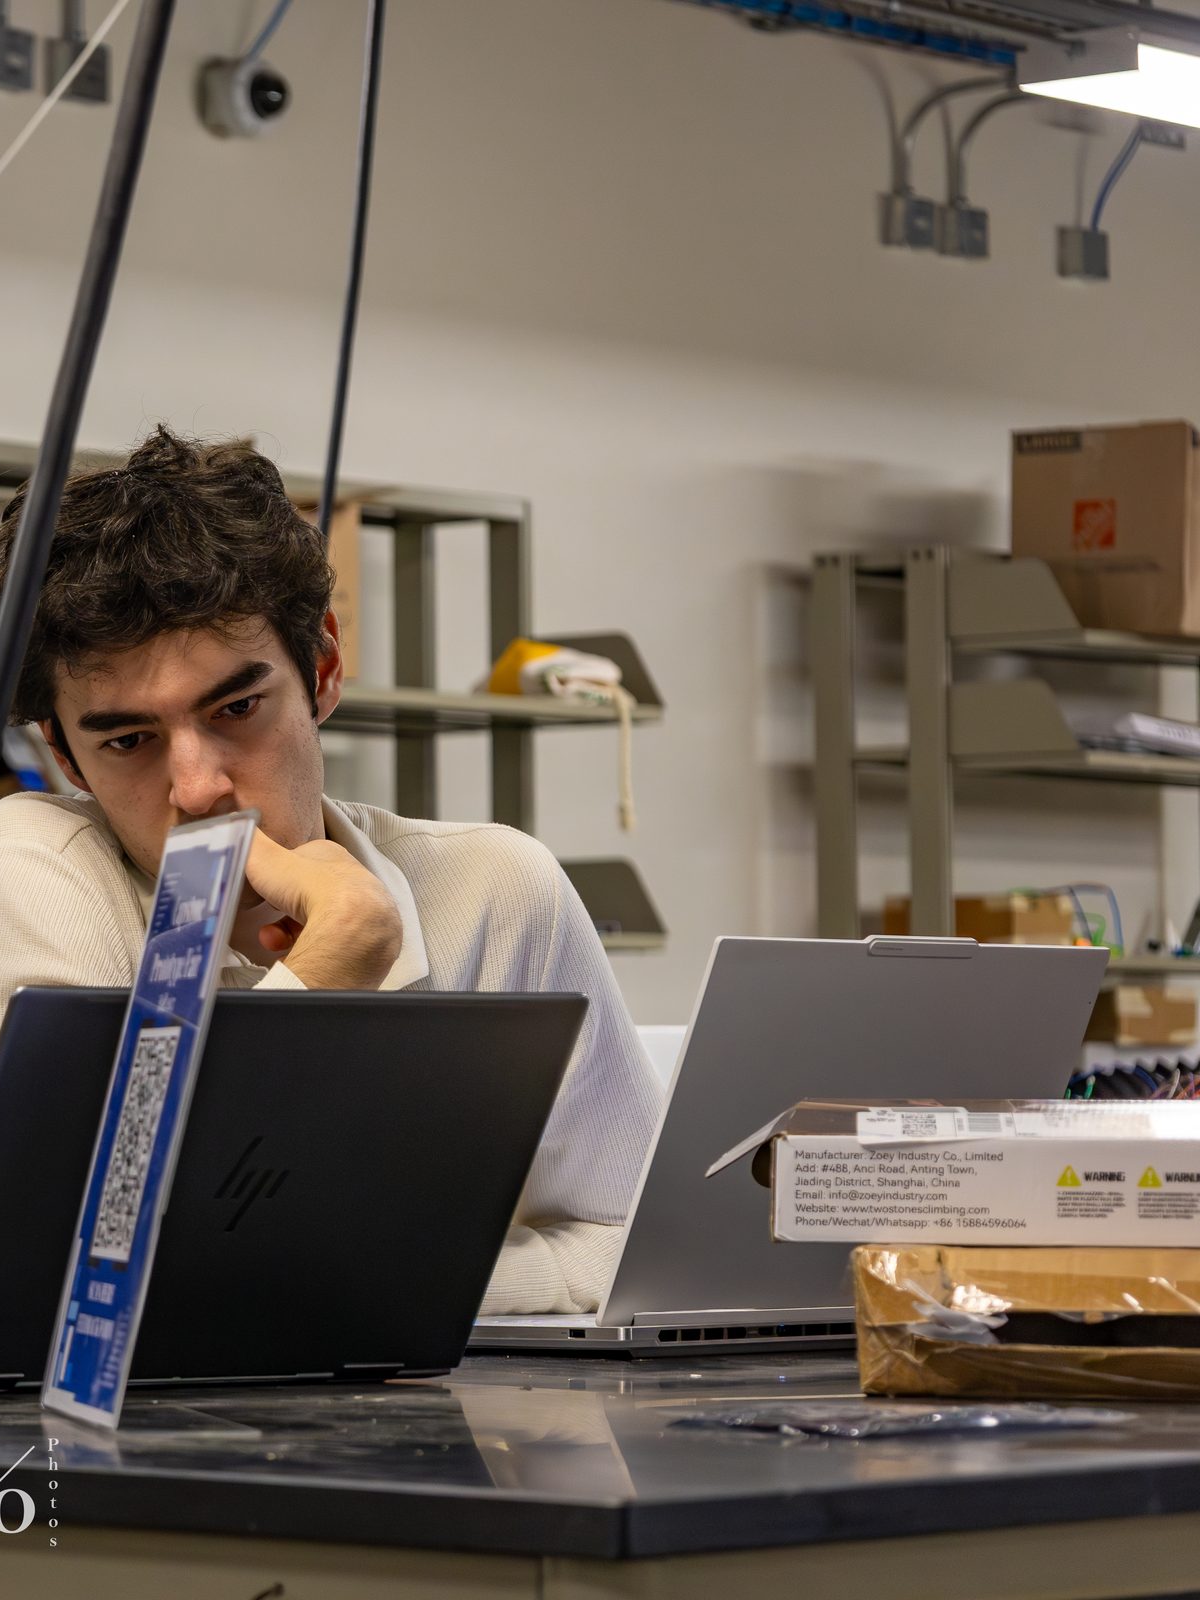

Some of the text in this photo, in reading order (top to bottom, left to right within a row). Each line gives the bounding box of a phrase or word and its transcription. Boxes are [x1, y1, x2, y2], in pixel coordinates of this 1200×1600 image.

[795, 1150, 1004, 1163] Manufacturer: Zoey Industry Co., Limited
[795, 1163, 978, 1176] Add: #488, Anci Road, Anting Town,
[1084, 1171, 1126, 1181] WARNING
[795, 1177, 961, 1189] Jiading District, Shanghai, China
[795, 1190, 948, 1202] Email: info@zoeyindustry.com
[795, 1203, 991, 1216] Website: www.twostonesclimbing.com
[795, 1216, 931, 1229] Phone/Wechat/Whatsapp:
[933, 1218, 953, 1228] +86
